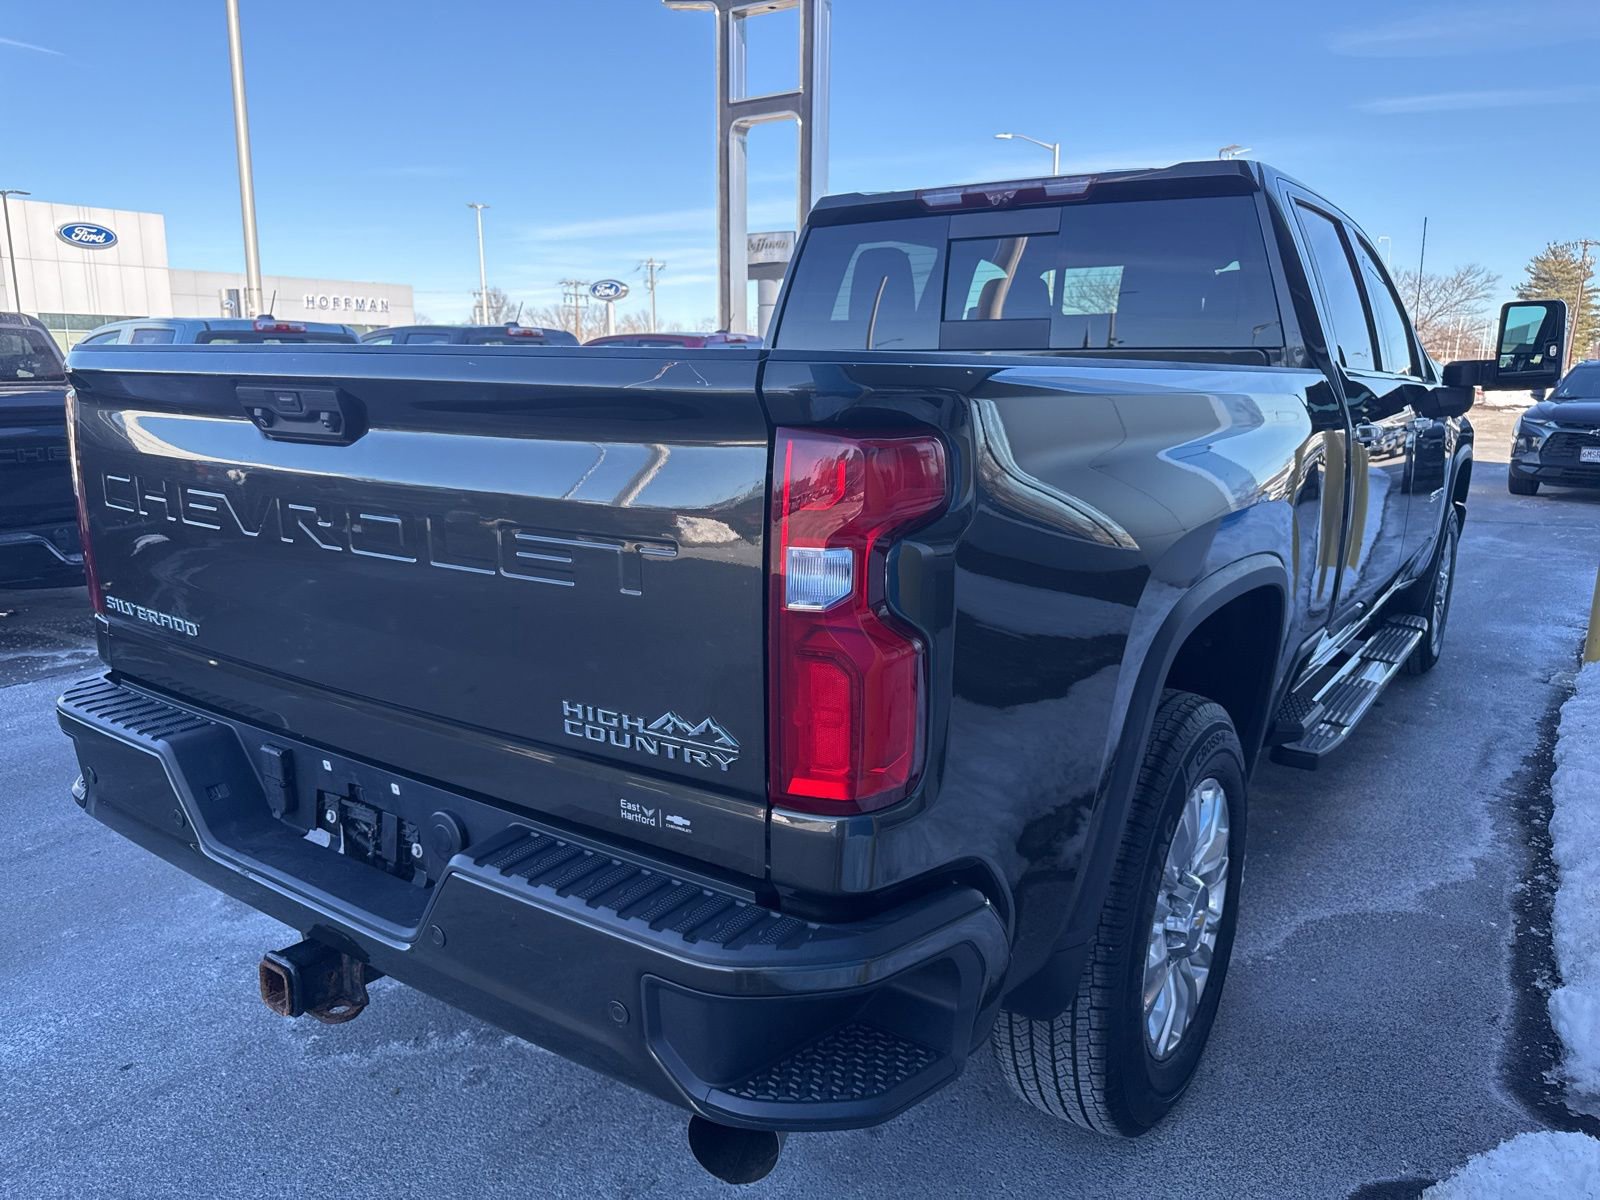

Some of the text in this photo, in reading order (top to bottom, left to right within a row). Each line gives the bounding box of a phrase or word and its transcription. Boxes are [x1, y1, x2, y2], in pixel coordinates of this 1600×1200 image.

[71, 226, 105, 243] Ford
[595, 284, 616, 296] Ford
[305, 305, 390, 313] HOFFMAN
[102, 474, 678, 597] CHEVROLET
[105, 596, 200, 637] SILVERADO
[562, 700, 645, 733] HIGH
[563, 719, 741, 771] COUNTRY
[620, 798, 640, 812] East
[620, 809, 656, 826] Hartford
